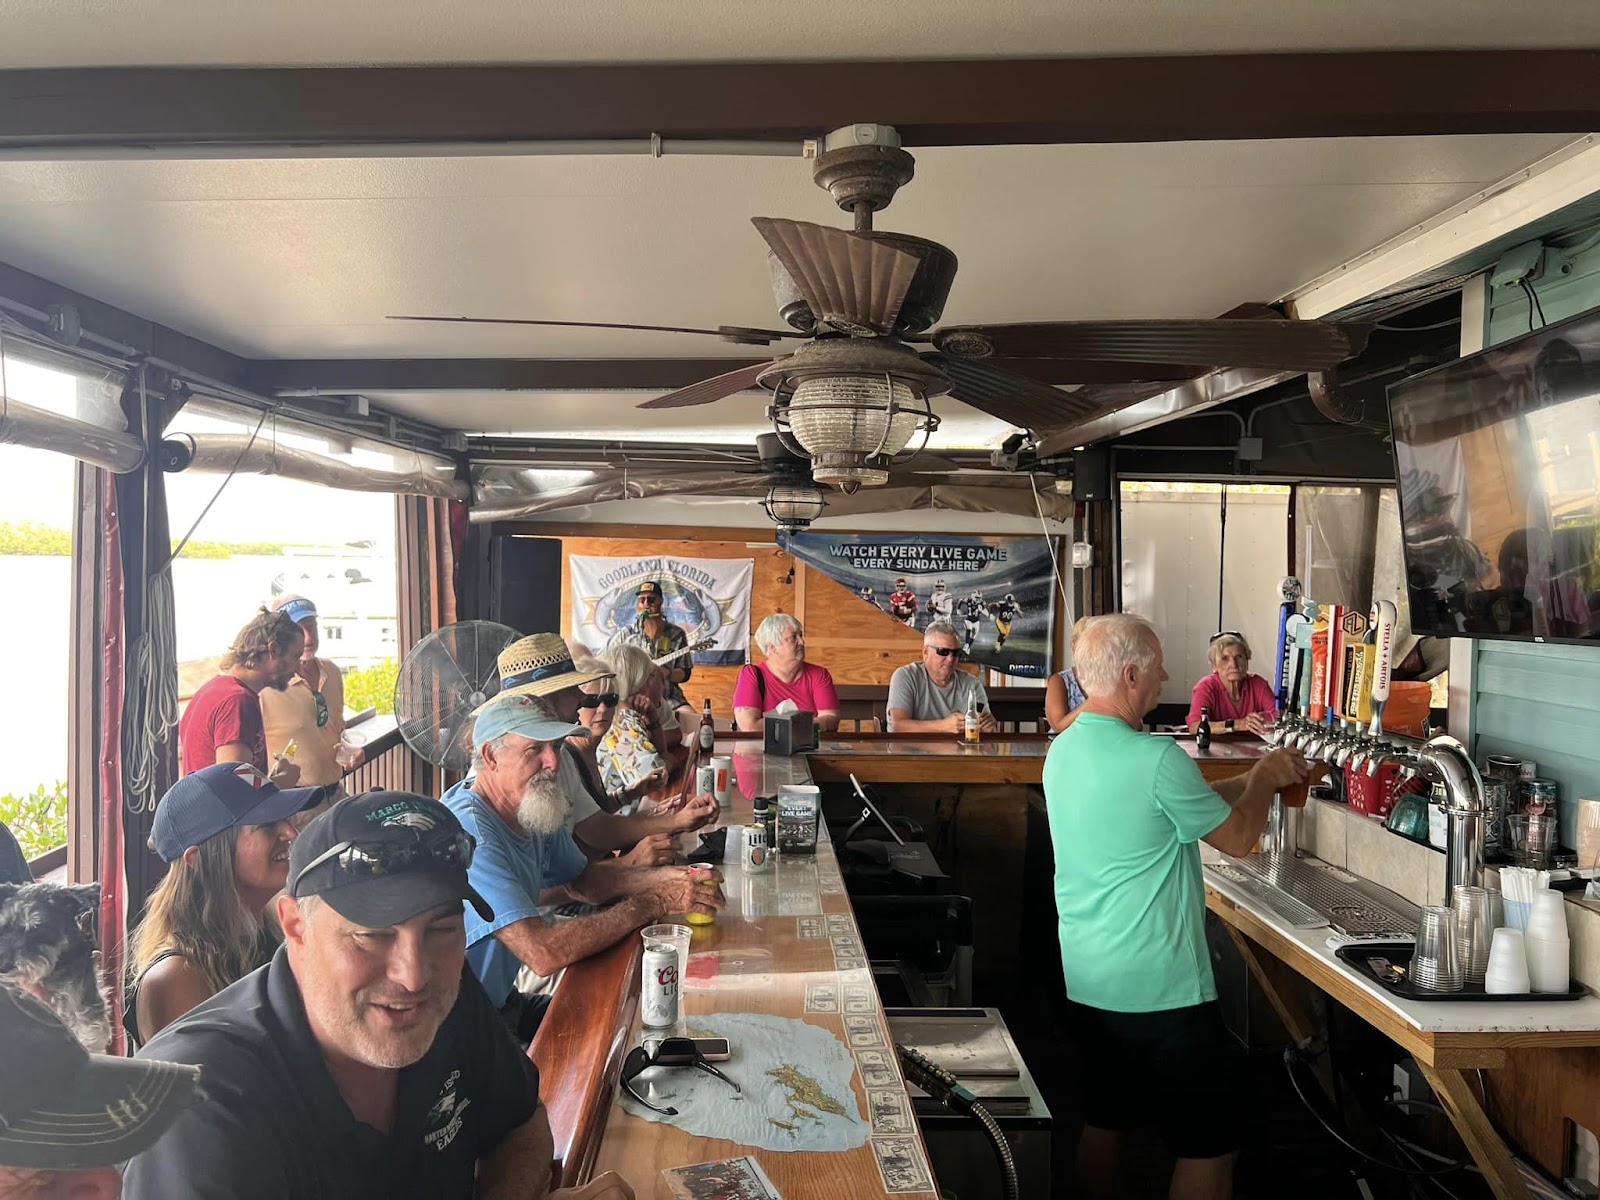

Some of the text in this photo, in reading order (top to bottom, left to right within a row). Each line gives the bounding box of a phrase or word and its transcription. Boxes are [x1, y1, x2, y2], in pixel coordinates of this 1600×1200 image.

[829, 545, 1007, 561] WATCH EVERY LIVE GAME
[598, 558, 717, 590] GOODLAND FLORIDA
[853, 558, 979, 571] EVERY SUNDAY HERE
[1379, 623, 1391, 689] STELLA ARTOIS
[1009, 664, 1046, 675] DIRECTV
[1312, 662, 1325, 705] SHOCK TOP
[365, 801, 409, 821] MARCO
